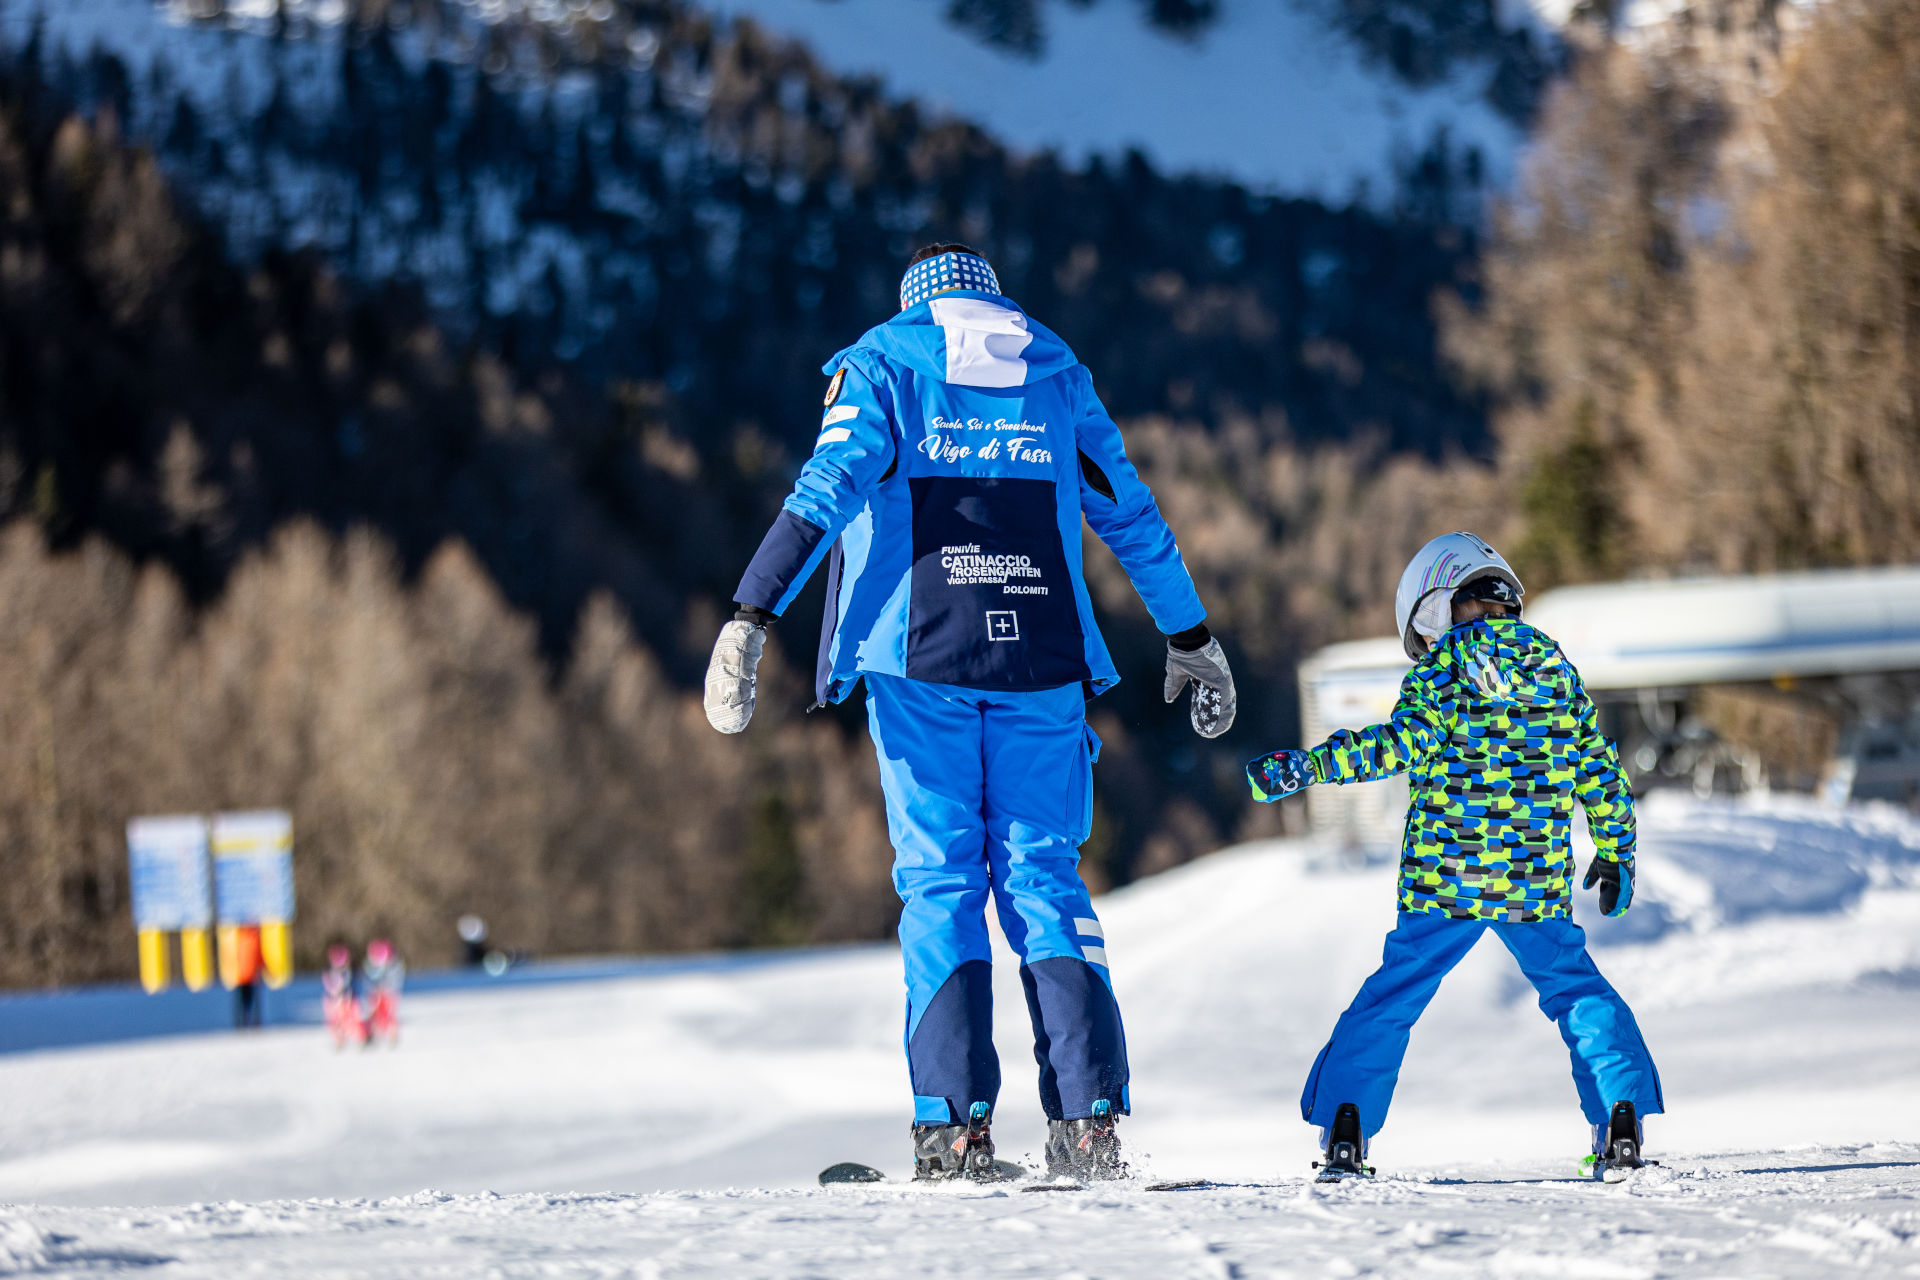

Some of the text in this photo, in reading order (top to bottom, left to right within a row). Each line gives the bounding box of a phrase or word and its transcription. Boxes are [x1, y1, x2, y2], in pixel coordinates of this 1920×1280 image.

[932, 416, 1047, 434] Scuola Sci e Snowboard
[917, 434, 973, 463] Vigo
[978, 437, 1000, 460] di
[941, 542, 980, 554] FUNIVIE
[941, 555, 1031, 573] CATINACCIO
[947, 575, 967, 585] VIGO
[955, 567, 1041, 583] ROSENGARTEN
[1003, 586, 1048, 595] DOLOMITI
